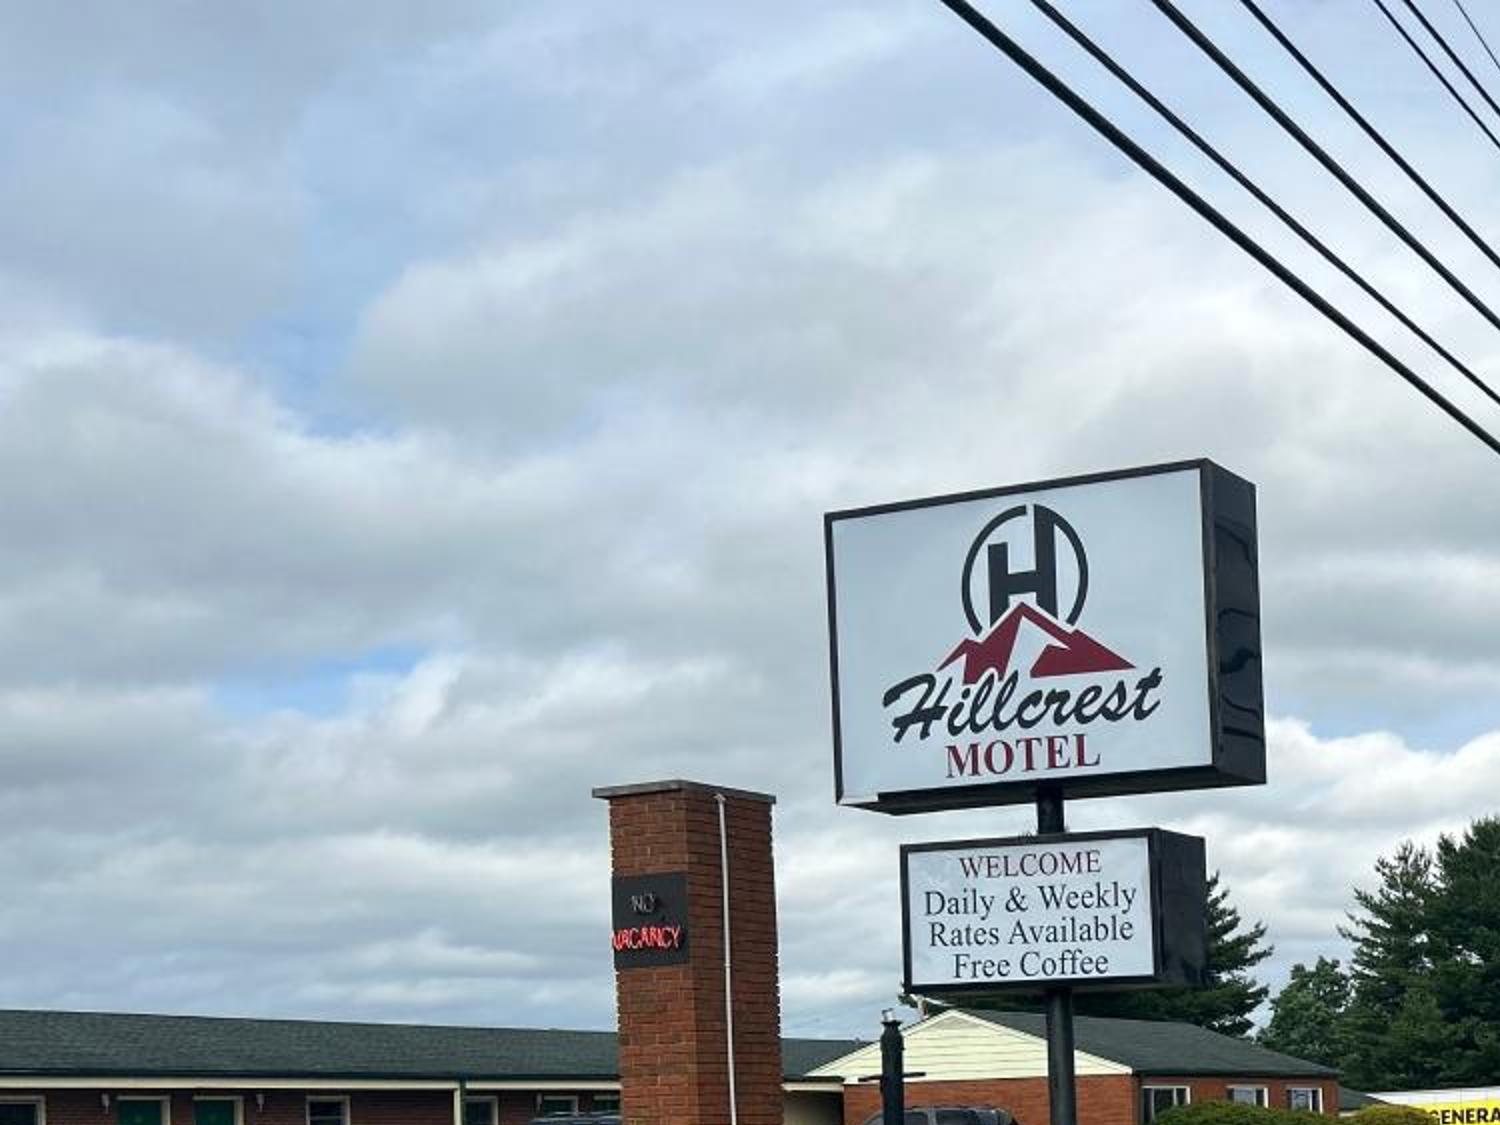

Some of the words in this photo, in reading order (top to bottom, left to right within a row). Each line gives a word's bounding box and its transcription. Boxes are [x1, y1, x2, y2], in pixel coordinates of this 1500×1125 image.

[882, 667, 1163, 744] Hillcrest
[945, 733, 1101, 779] MOTEL
[959, 850, 1102, 880] WELCOME
[630, 891, 656, 913] NO
[924, 888, 995, 921] Daily
[1005, 886, 1029, 913] &
[1037, 881, 1137, 914] Weekly
[613, 924, 681, 952] VACANCY
[929, 921, 1000, 947] Rates
[1007, 915, 1135, 945] Available
[952, 953, 1011, 979] Free
[1019, 949, 1109, 977] Coffee
